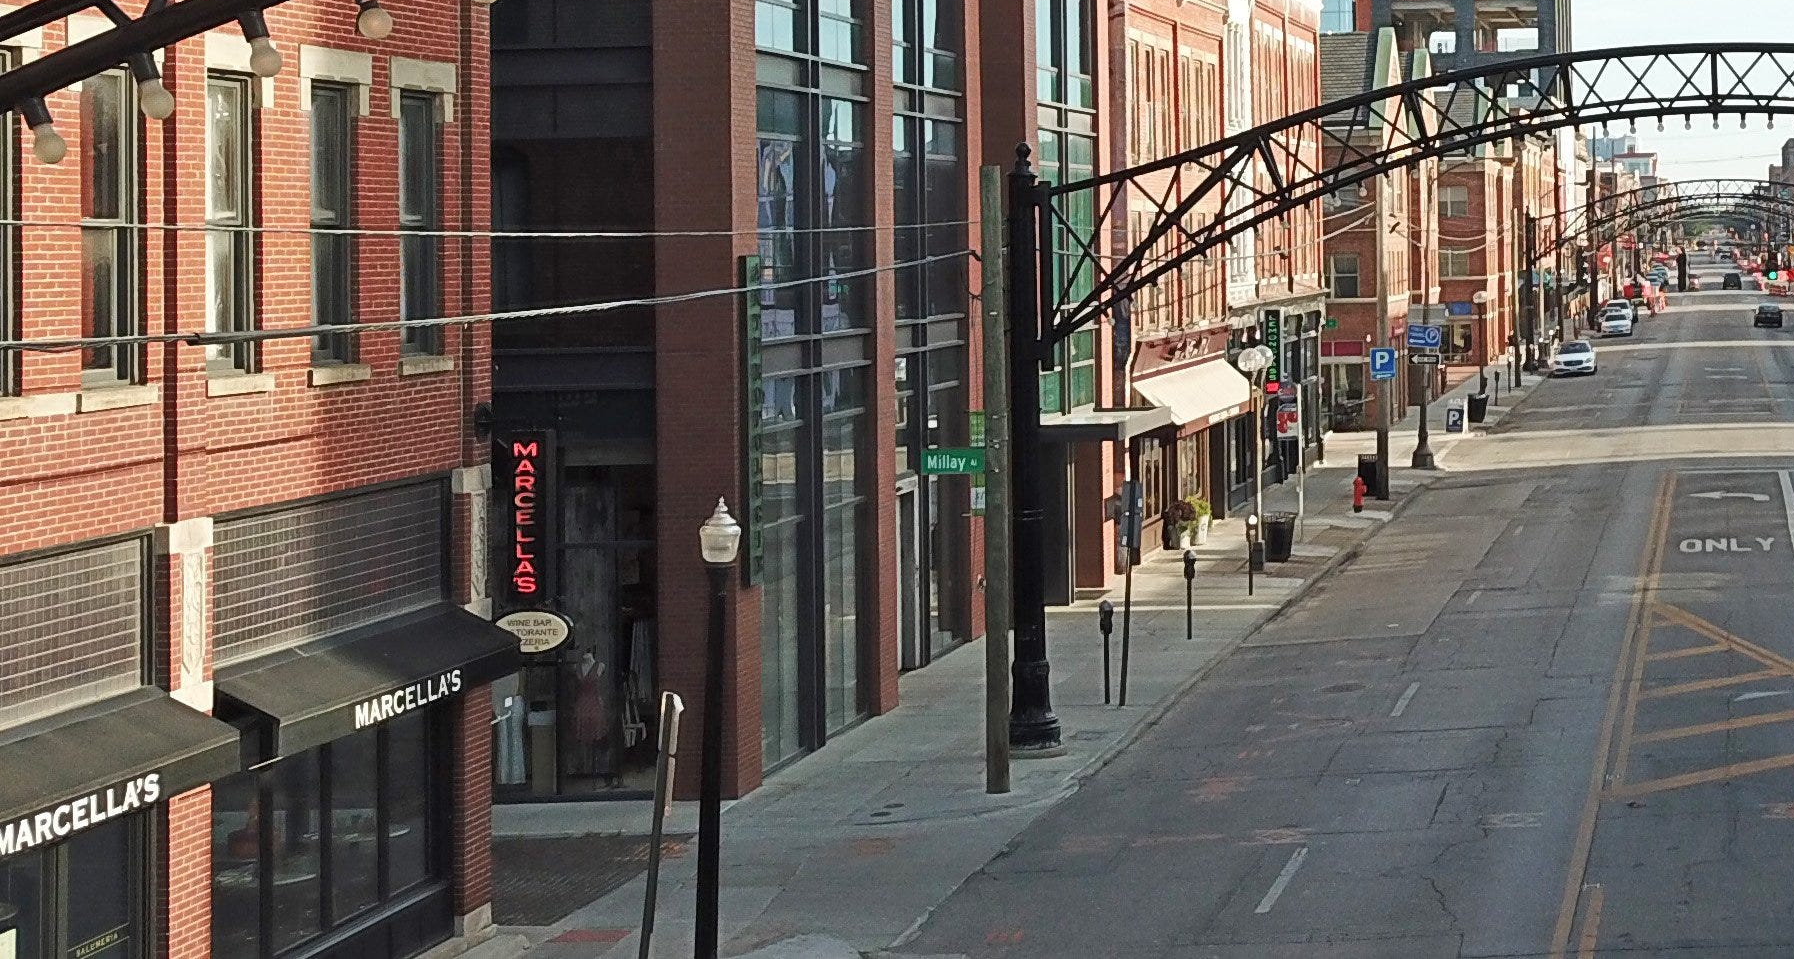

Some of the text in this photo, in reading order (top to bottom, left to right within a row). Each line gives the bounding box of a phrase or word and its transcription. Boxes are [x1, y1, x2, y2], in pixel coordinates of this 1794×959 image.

[927, 454, 966, 471] Millay
[514, 441, 538, 593] MARCELLA'S
[1679, 537, 1775, 553] ONLY
[507, 619, 552, 627] WINE BAR
[511, 628, 559, 637] TORANTE
[355, 669, 461, 730] MARCELLA'S
[0, 773, 160, 856] MARCELLA'S
